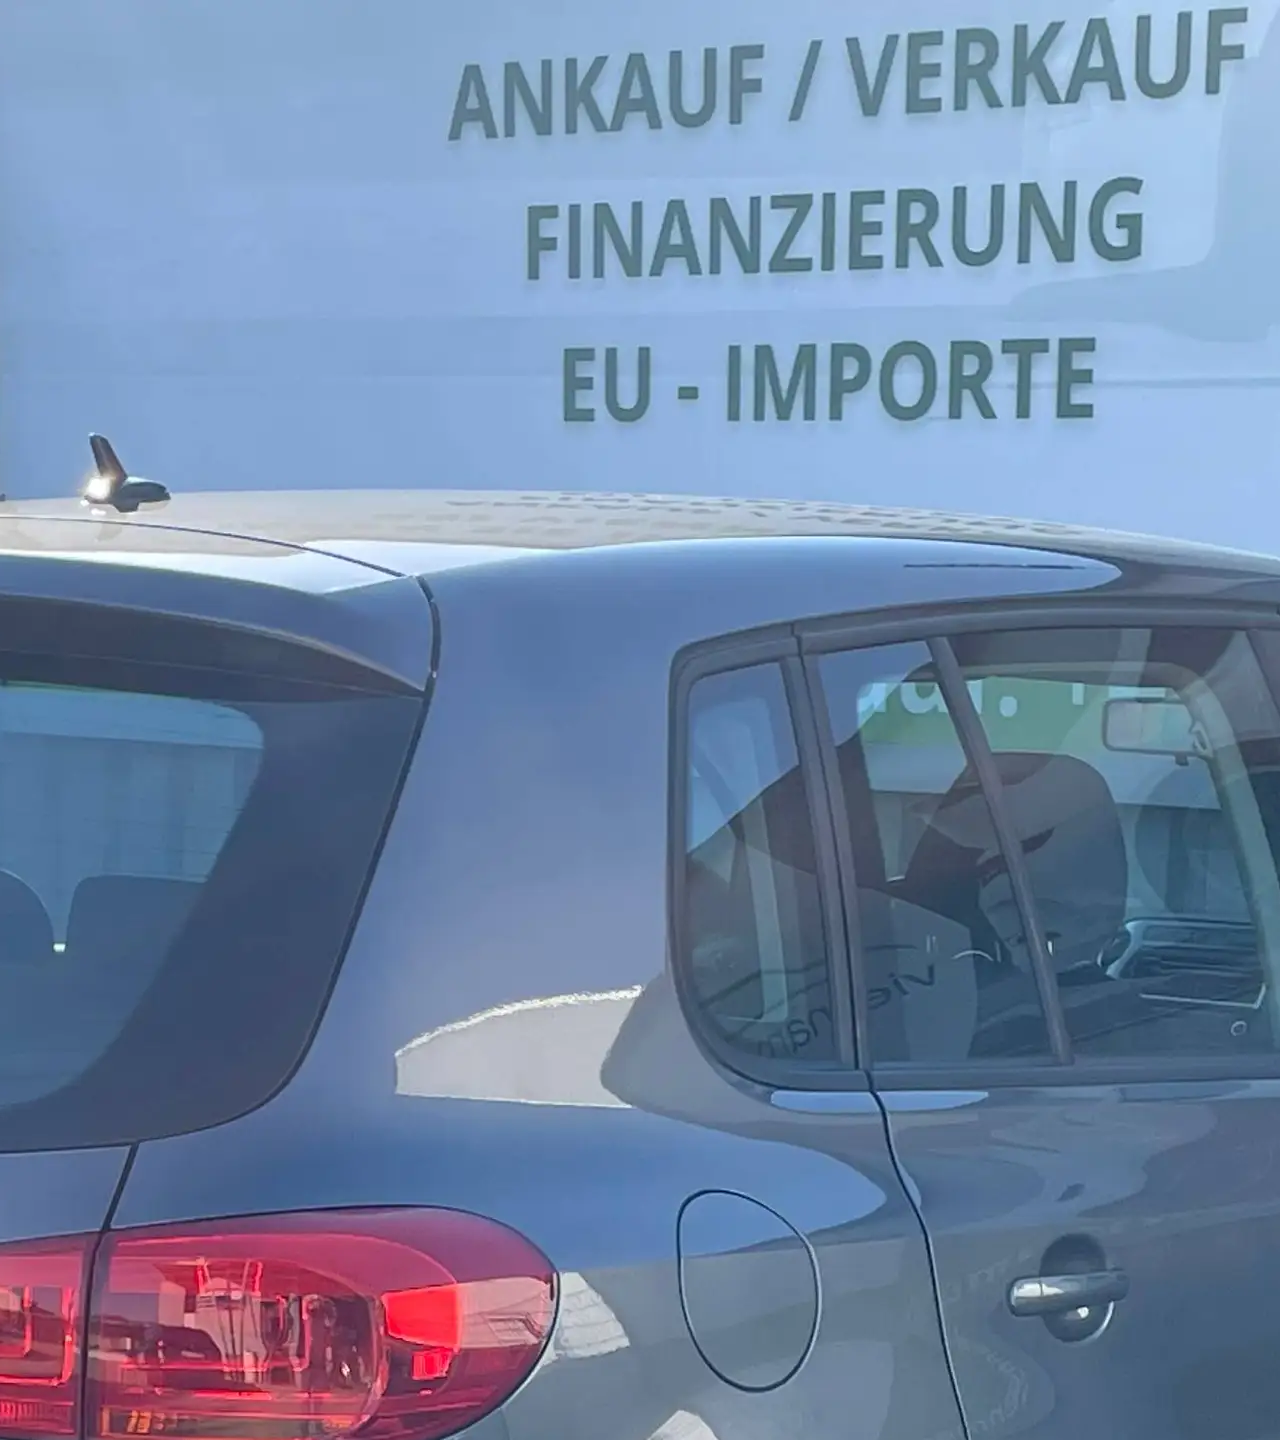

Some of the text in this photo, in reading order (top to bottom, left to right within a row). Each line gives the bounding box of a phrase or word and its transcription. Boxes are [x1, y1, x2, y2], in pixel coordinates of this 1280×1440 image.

[447, 43, 766, 142] ANKAUF
[844, 7, 1250, 119] VERKAUF
[525, 175, 1145, 281] FINANZIERUNG
[561, 346, 652, 424] EU
[726, 336, 1098, 423] IMPORTE
